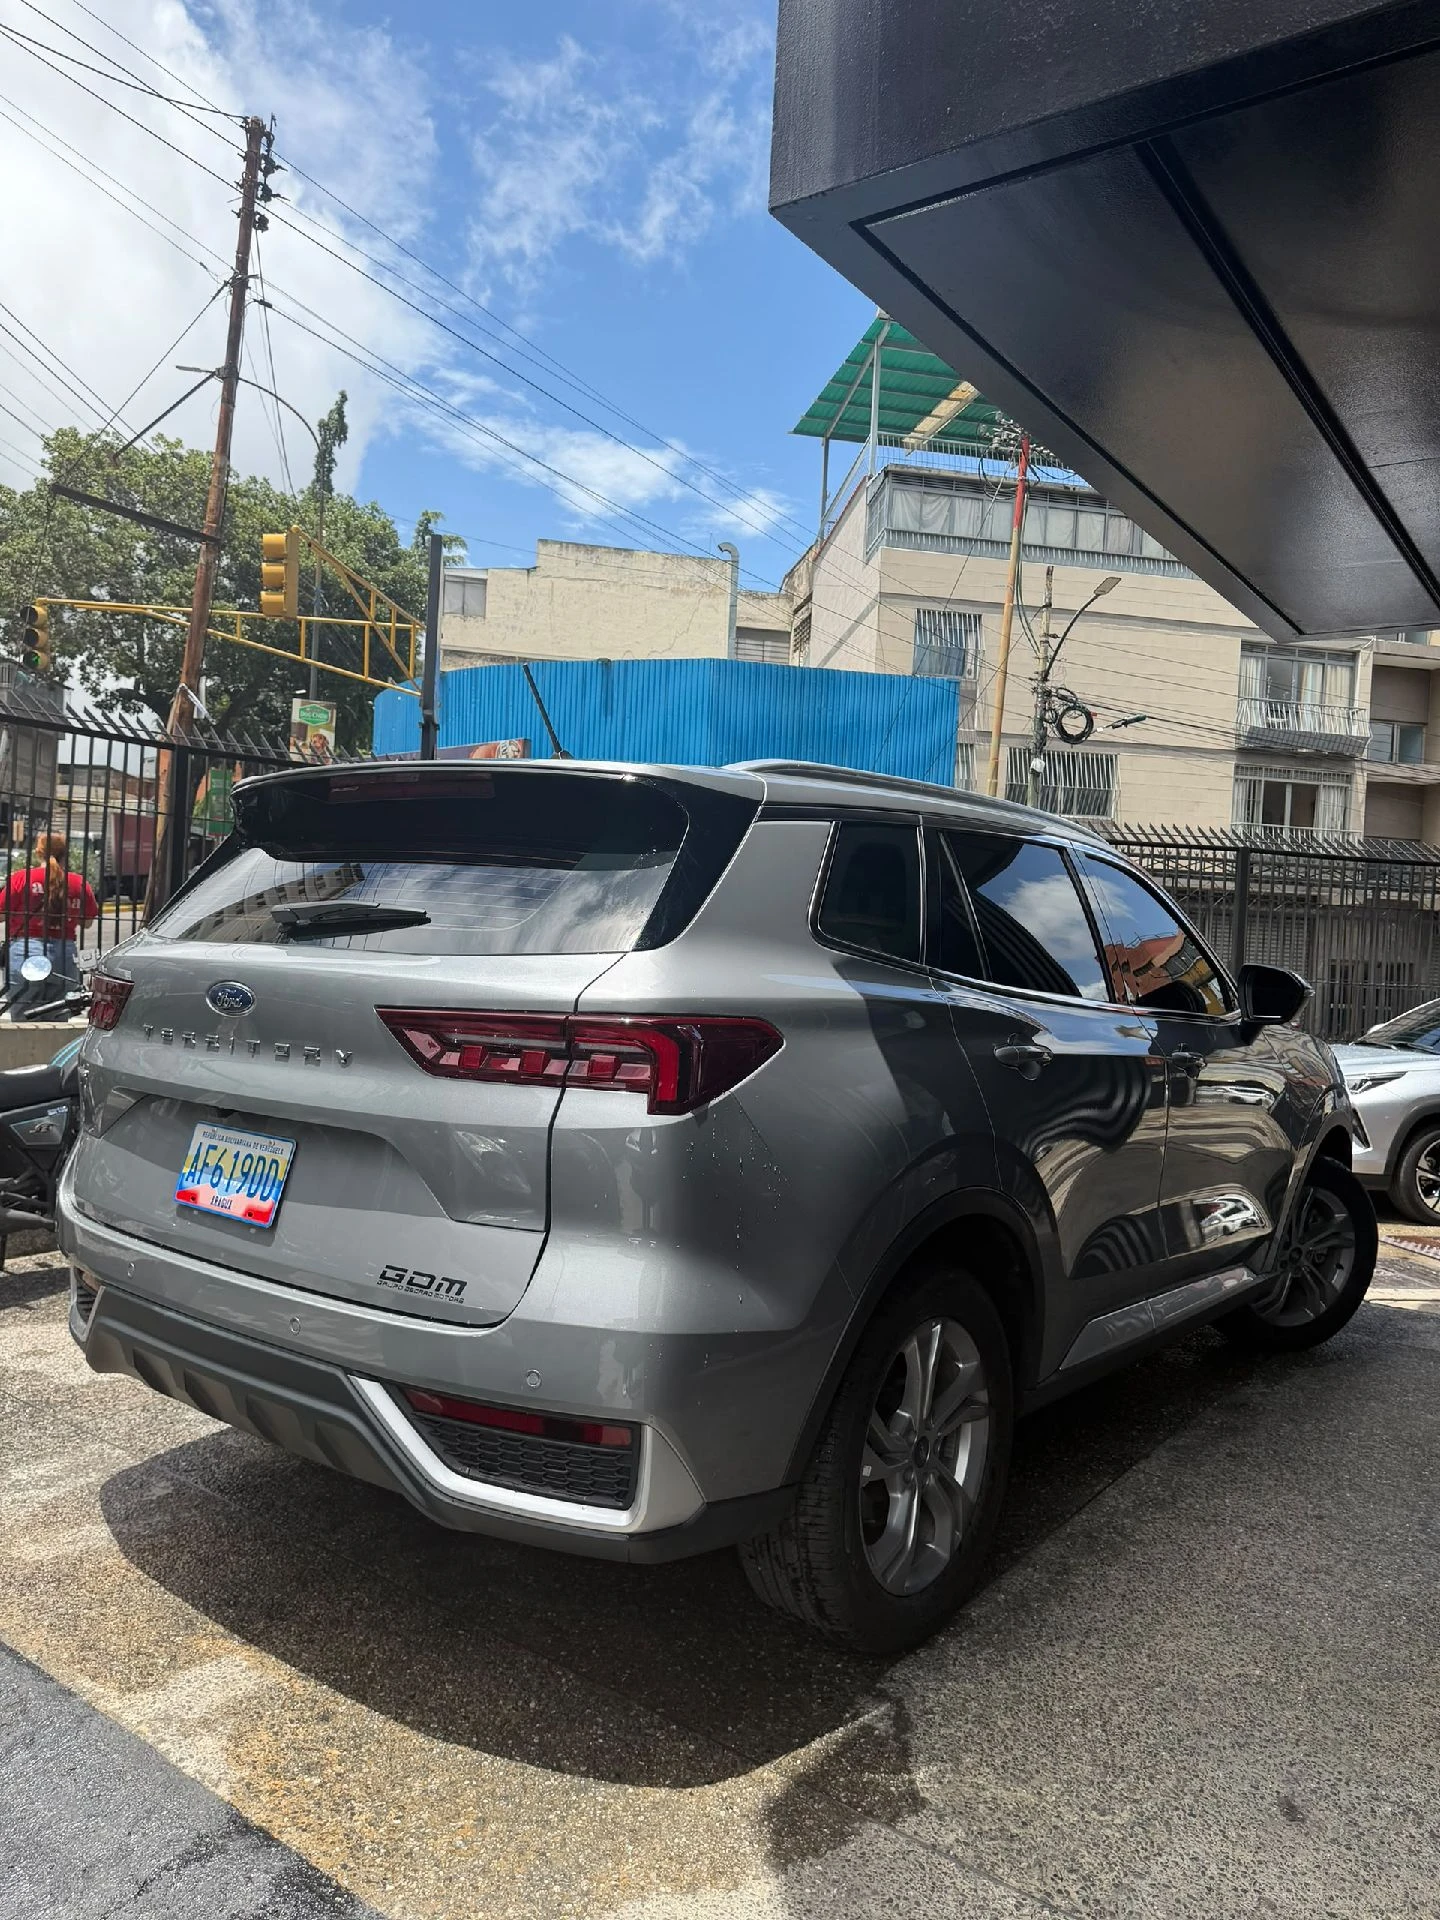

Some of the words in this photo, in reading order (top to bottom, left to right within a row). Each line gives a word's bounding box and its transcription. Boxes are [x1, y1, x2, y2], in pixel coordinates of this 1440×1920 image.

[217, 989, 243, 1008] Ford
[143, 1024, 352, 1066] TERRITORY
[185, 1141, 280, 1202] AF619DD
[379, 1264, 468, 1296] GDM
